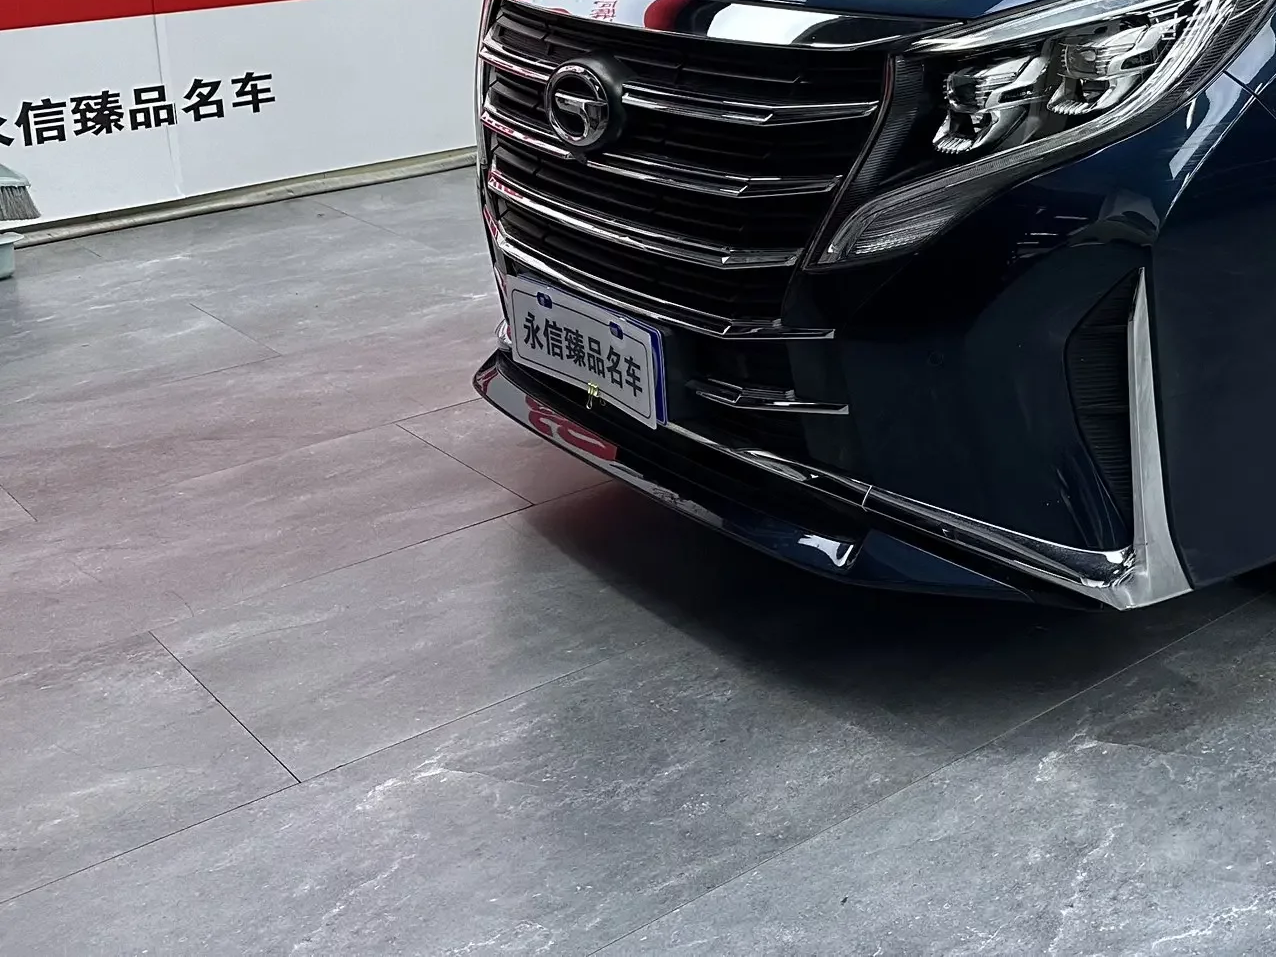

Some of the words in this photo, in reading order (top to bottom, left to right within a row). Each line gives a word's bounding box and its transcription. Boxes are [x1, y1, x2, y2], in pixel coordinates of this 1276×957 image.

[0, 71, 276, 148] 信臻品名车
[522, 311, 643, 398] 永信臻品名车
